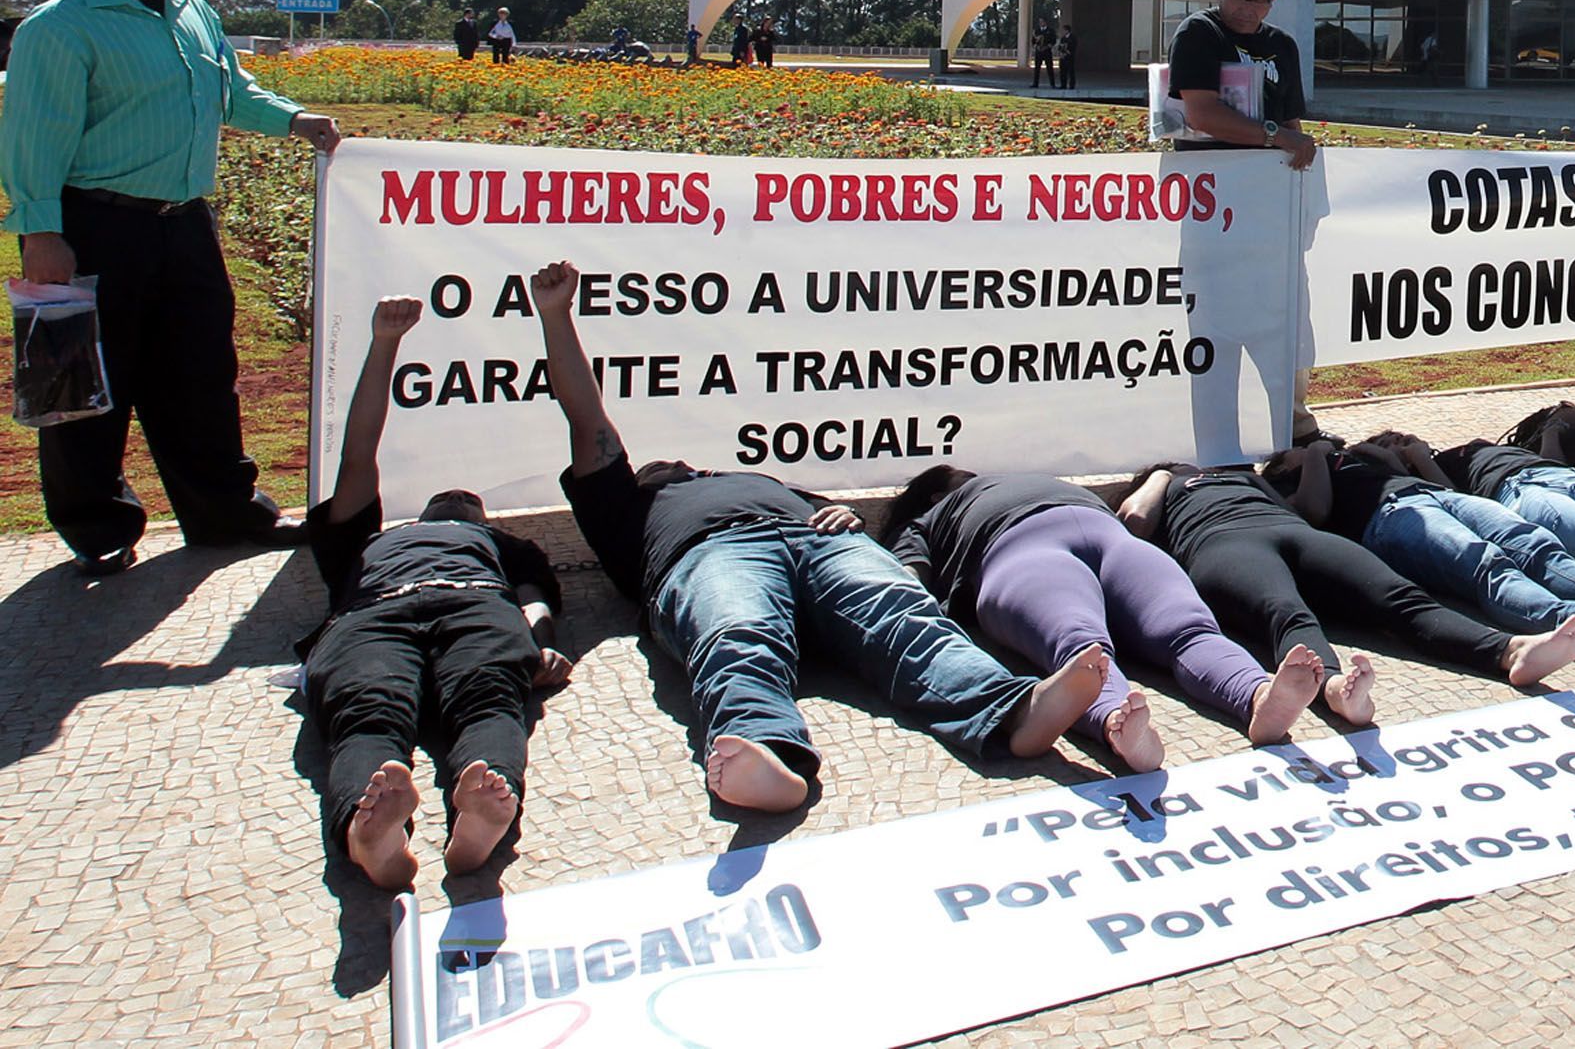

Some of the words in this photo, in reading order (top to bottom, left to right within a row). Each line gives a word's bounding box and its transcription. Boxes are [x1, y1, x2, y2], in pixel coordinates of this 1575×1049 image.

[379, 170, 726, 235] MULHERES,
[753, 172, 959, 223] POBRES
[972, 174, 1003, 221] E
[1027, 172, 1234, 232] NEGROS,
[430, 273, 473, 319] O
[492, 272, 730, 318] AESSO
[747, 272, 786, 313] A
[805, 266, 1198, 314] UNIVERSIDADE,
[1350, 265, 1452, 342] NOS
[698, 353, 738, 396] A
[756, 329, 1216, 394] TRANSFORMAÇÃO
[735, 415, 963, 466] SOCIAL?
[1216, 756, 1379, 801] vida
[1394, 722, 1551, 773] grita
[934, 869, 1083, 922] Por
[1104, 799, 1448, 883] inclusão,
[1460, 782, 1507, 802] o
[1087, 897, 1236, 955] Por
[1266, 826, 1574, 911] direitos,
[435, 883, 823, 1044] EDUCAFRO
